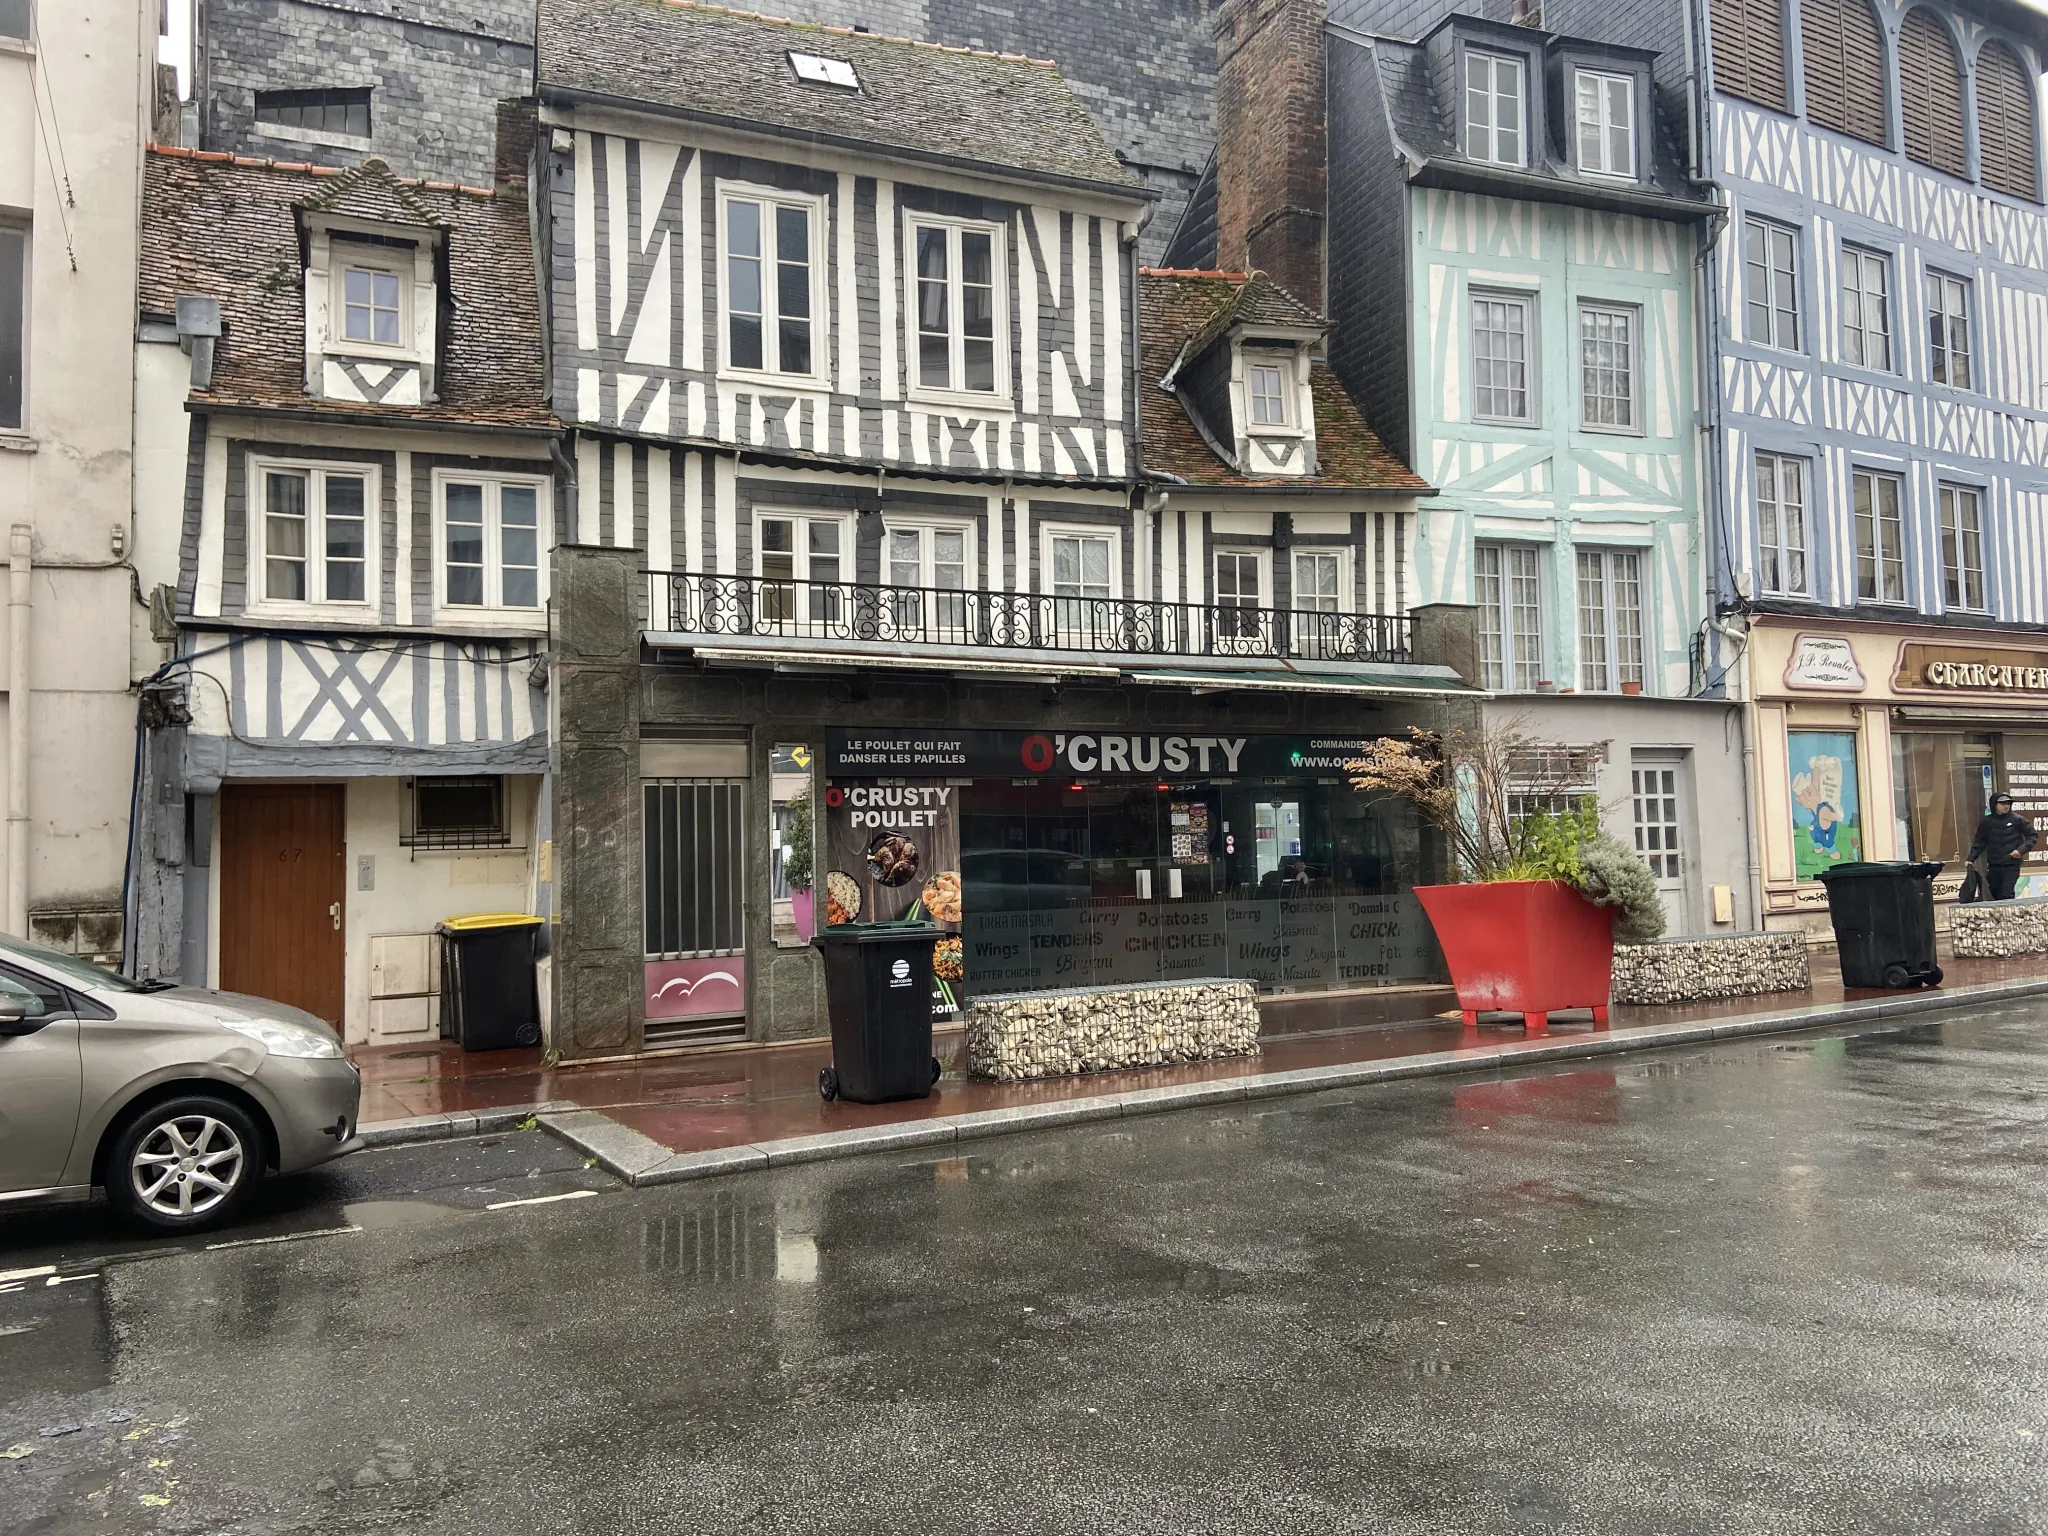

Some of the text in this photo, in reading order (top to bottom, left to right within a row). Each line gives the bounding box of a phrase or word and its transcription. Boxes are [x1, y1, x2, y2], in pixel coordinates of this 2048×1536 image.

[847, 740, 961, 751] LE POULET QUI FAIT
[1021, 734, 1247, 773] O'CRUSTY
[839, 753, 966, 764] DANSER LES PAPILLES
[825, 787, 951, 807] O'CRUSTY
[851, 810, 938, 828] POULET
[279, 848, 302, 862] 67
[1226, 907, 1261, 923] Curry
[1280, 900, 1336, 914] Potatoes
[1079, 910, 1120, 926] Curry
[1137, 911, 1209, 927] Potatoes
[1030, 931, 1104, 949] TENDERS
[1125, 931, 1227, 953] CHICKEN
[975, 943, 1020, 960] Wings
[1239, 942, 1291, 963] Wings
[1004, 967, 1042, 980] CHICKEN
